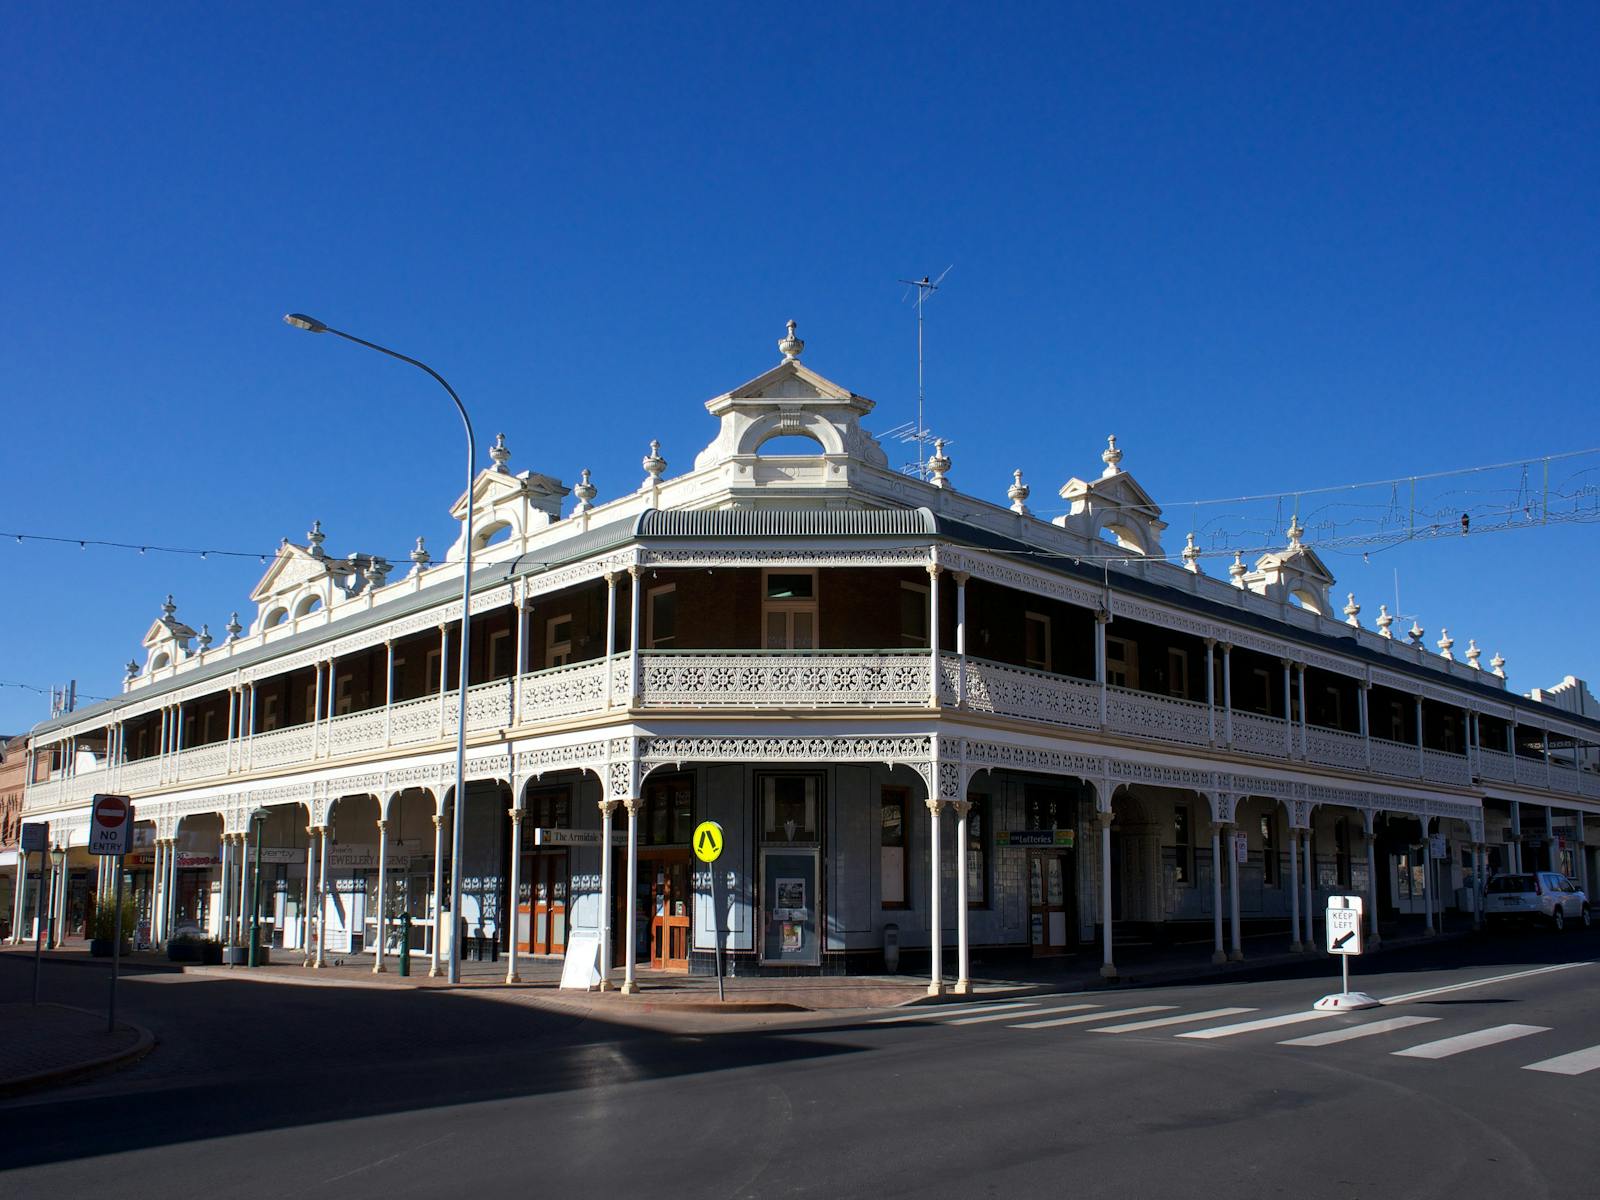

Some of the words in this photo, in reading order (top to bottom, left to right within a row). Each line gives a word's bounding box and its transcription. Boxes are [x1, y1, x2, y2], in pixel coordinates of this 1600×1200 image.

[101, 831, 117, 840] NO
[555, 832, 568, 841] The
[569, 832, 599, 841] Armidale
[93, 842, 122, 851] ENTRY
[1333, 912, 1352, 920] KEEP
